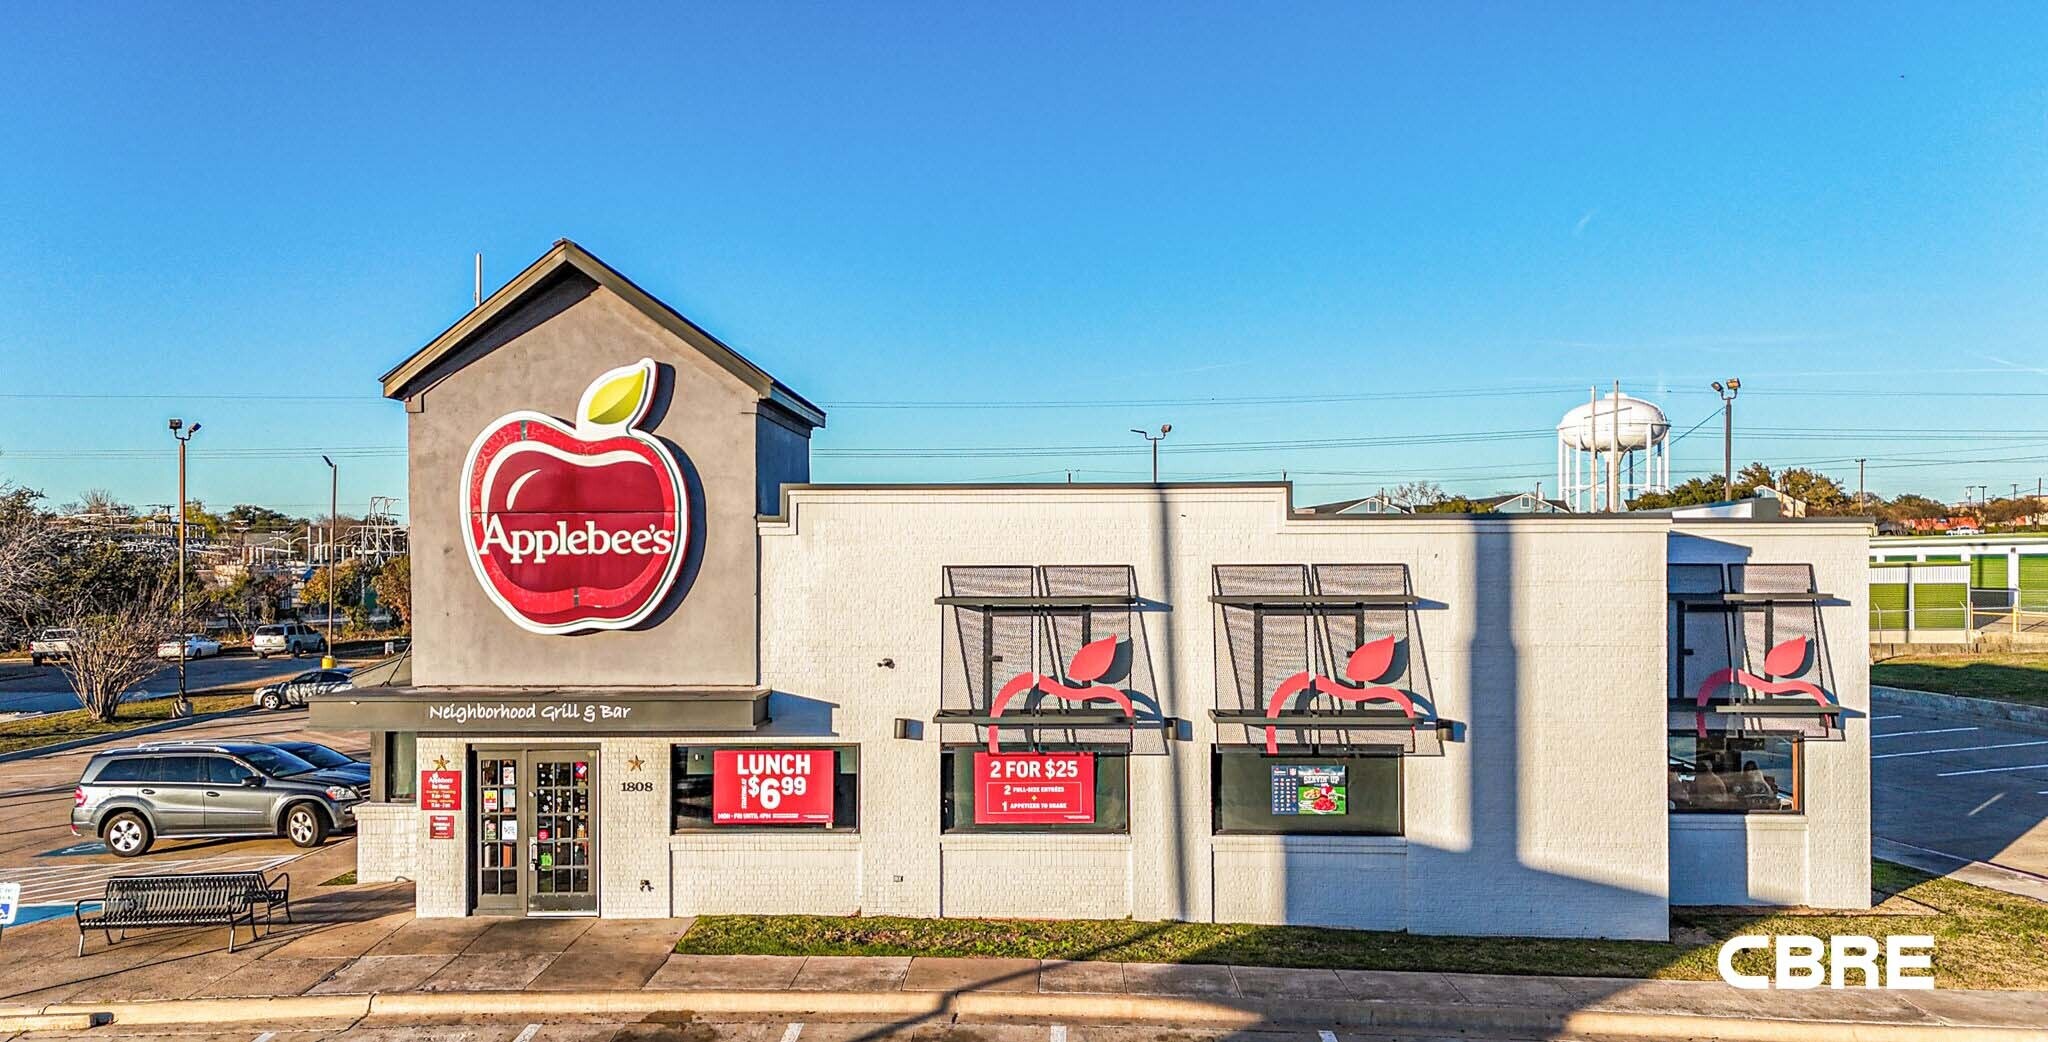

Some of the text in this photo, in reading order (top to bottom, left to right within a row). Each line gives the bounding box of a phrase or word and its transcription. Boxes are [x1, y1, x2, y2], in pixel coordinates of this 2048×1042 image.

[479, 512, 673, 564] Applebee's
[430, 704, 631, 724] Neighborhood Grill & Bar
[737, 754, 811, 775] LUNCH
[990, 759, 1078, 779] 2 FOR $25
[621, 782, 653, 792] 1808
[1004, 785, 1011, 795] 2
[1002, 801, 1008, 811] 1
